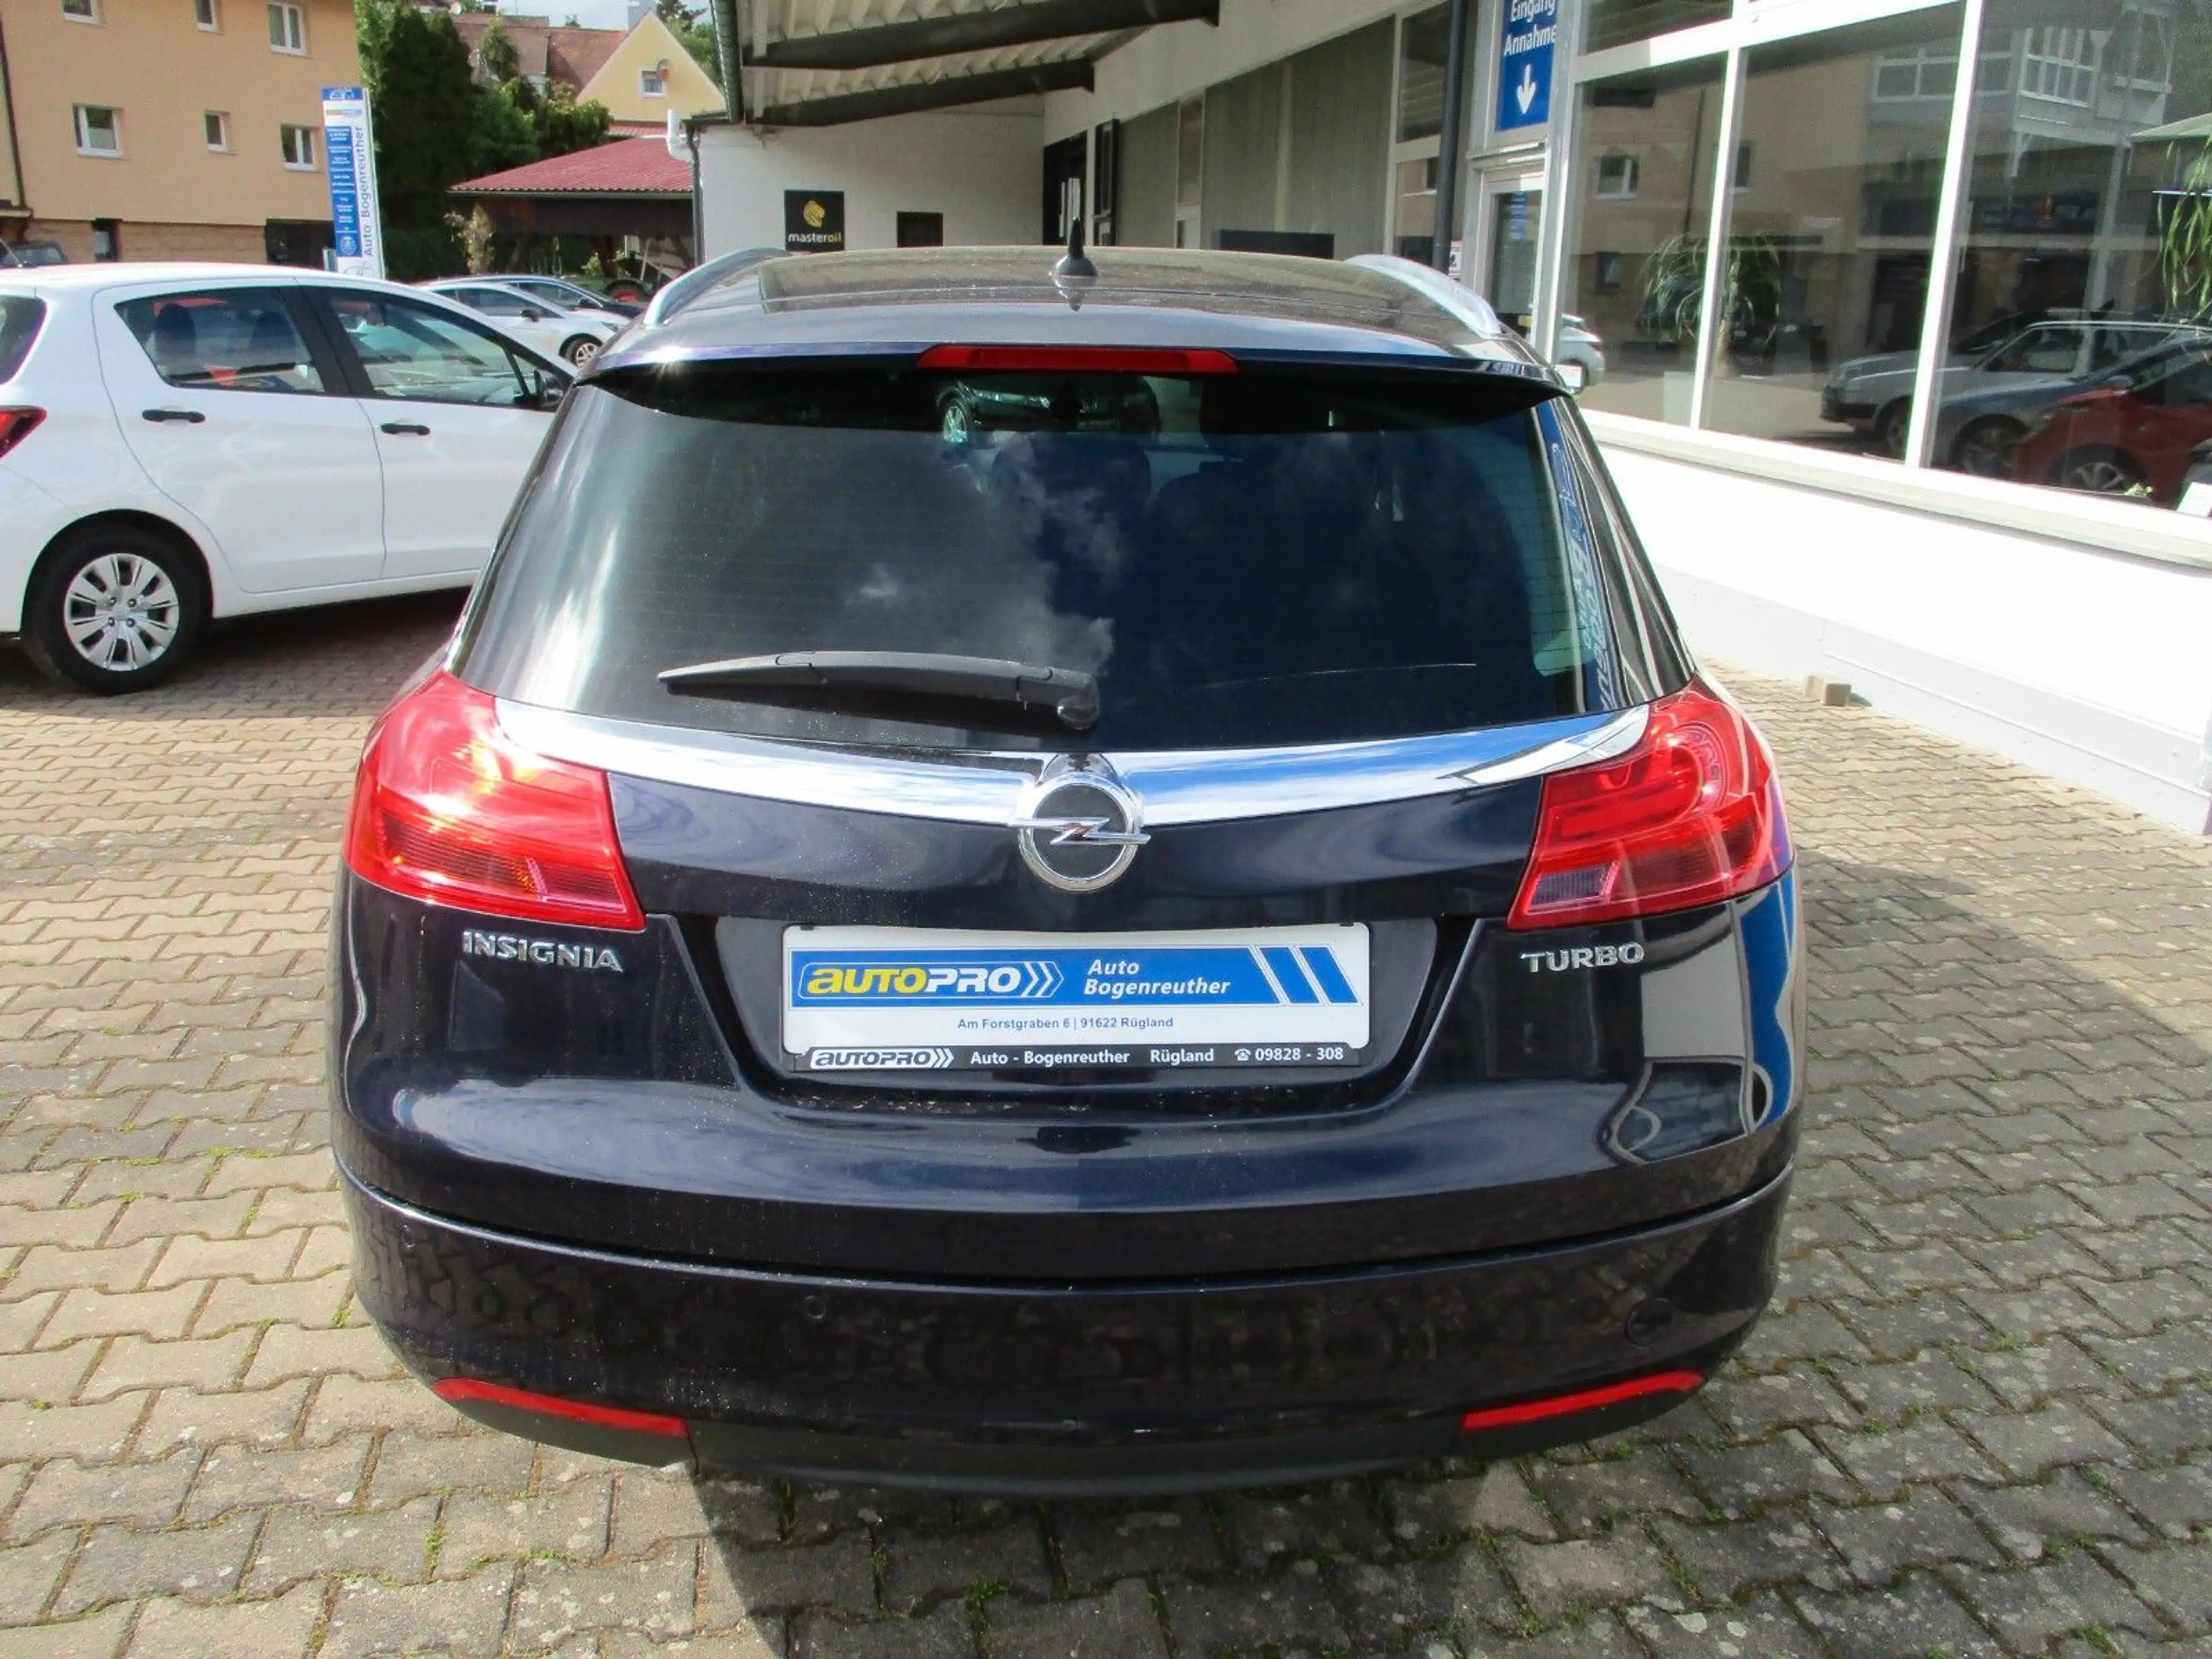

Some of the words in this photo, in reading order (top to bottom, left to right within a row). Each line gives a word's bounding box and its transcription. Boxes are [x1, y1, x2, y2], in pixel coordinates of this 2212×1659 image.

[1504, 24, 1557, 56] Annahme
[354, 126, 371, 218] Bogenreuther
[363, 222, 373, 256] Auto
[788, 232, 842, 243] masteroil
[463, 930, 624, 974] INSIGNIA
[1520, 941, 1645, 973] TURBO
[1088, 959, 1140, 975] Auto
[1084, 978, 1232, 1000] Bogenreuther
[957, 1019, 979, 1029] Am
[982, 1018, 1060, 1031] Forstgraben
[1063, 1018, 1070, 1028] 6
[1080, 1017, 1116, 1028] 91622
[1121, 1016, 1174, 1029] Rügland
[970, 1050, 1008, 1065] Auto
[1024, 1048, 1130, 1069] Bogenreuther
[1150, 1048, 1214, 1066] Rügland
[1255, 1047, 1301, 1062] 09828
[1316, 1047, 1344, 1060] 308
